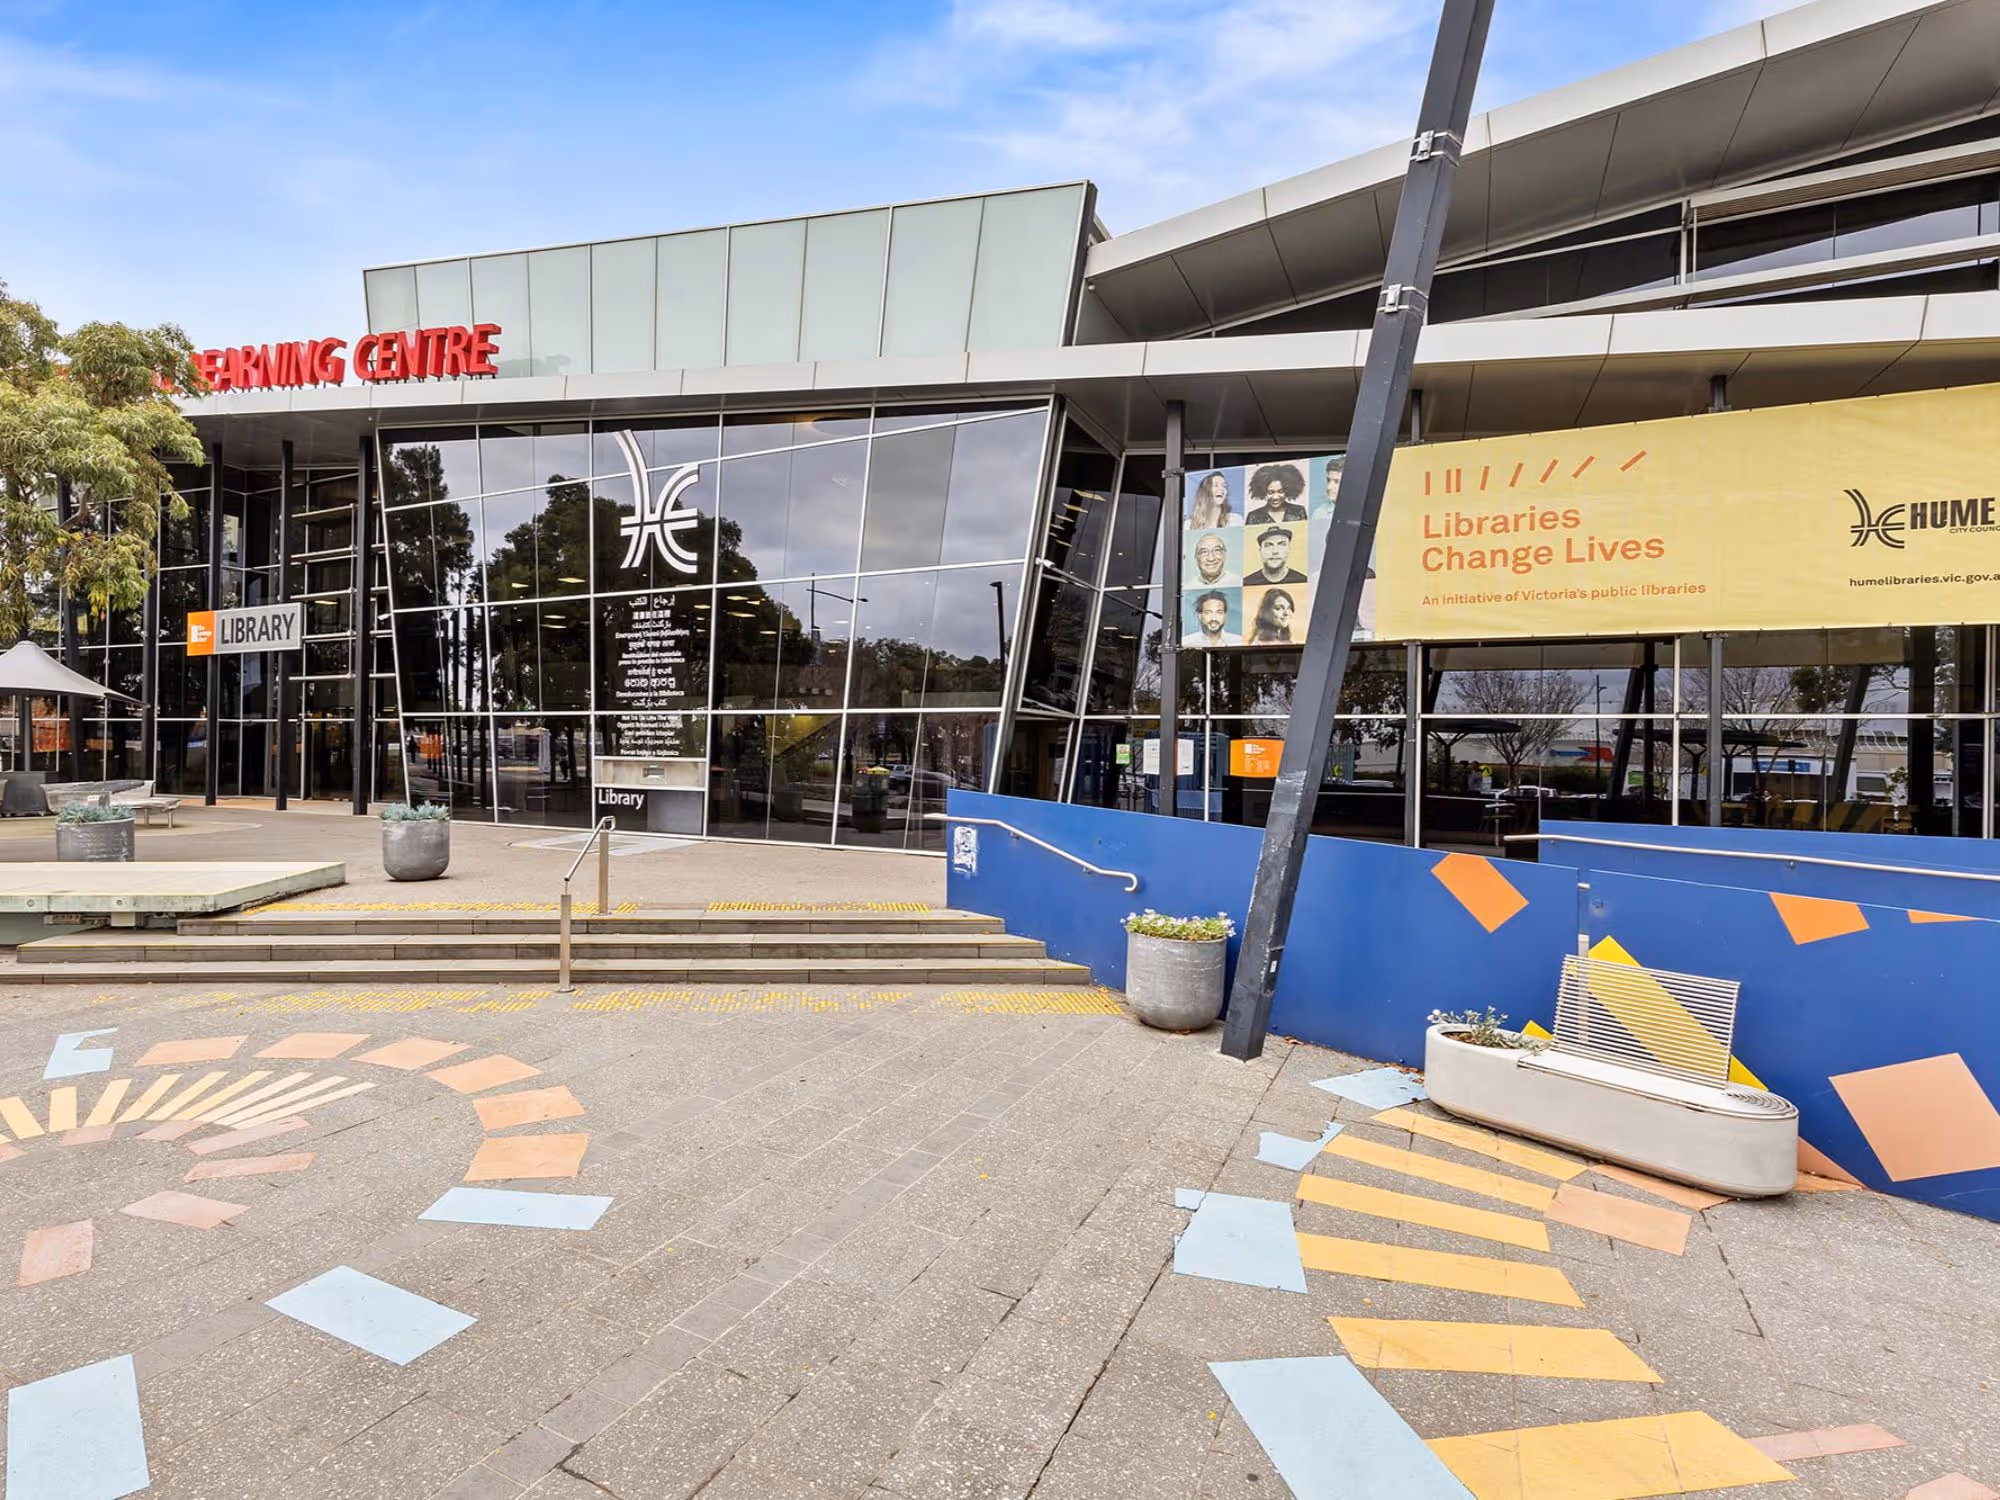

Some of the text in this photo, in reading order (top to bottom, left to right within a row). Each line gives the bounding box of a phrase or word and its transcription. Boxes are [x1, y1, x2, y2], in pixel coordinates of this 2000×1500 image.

[354, 323, 502, 381] CENTRE
[1424, 505, 1581, 539] Libraries
[1910, 497, 1995, 530] HUME
[1422, 536, 1665, 574] Change Lives
[1422, 583, 1706, 606] An initiative of Victoria's public libraries
[221, 612, 295, 644] LIBRARY
[598, 788, 644, 809] Library
